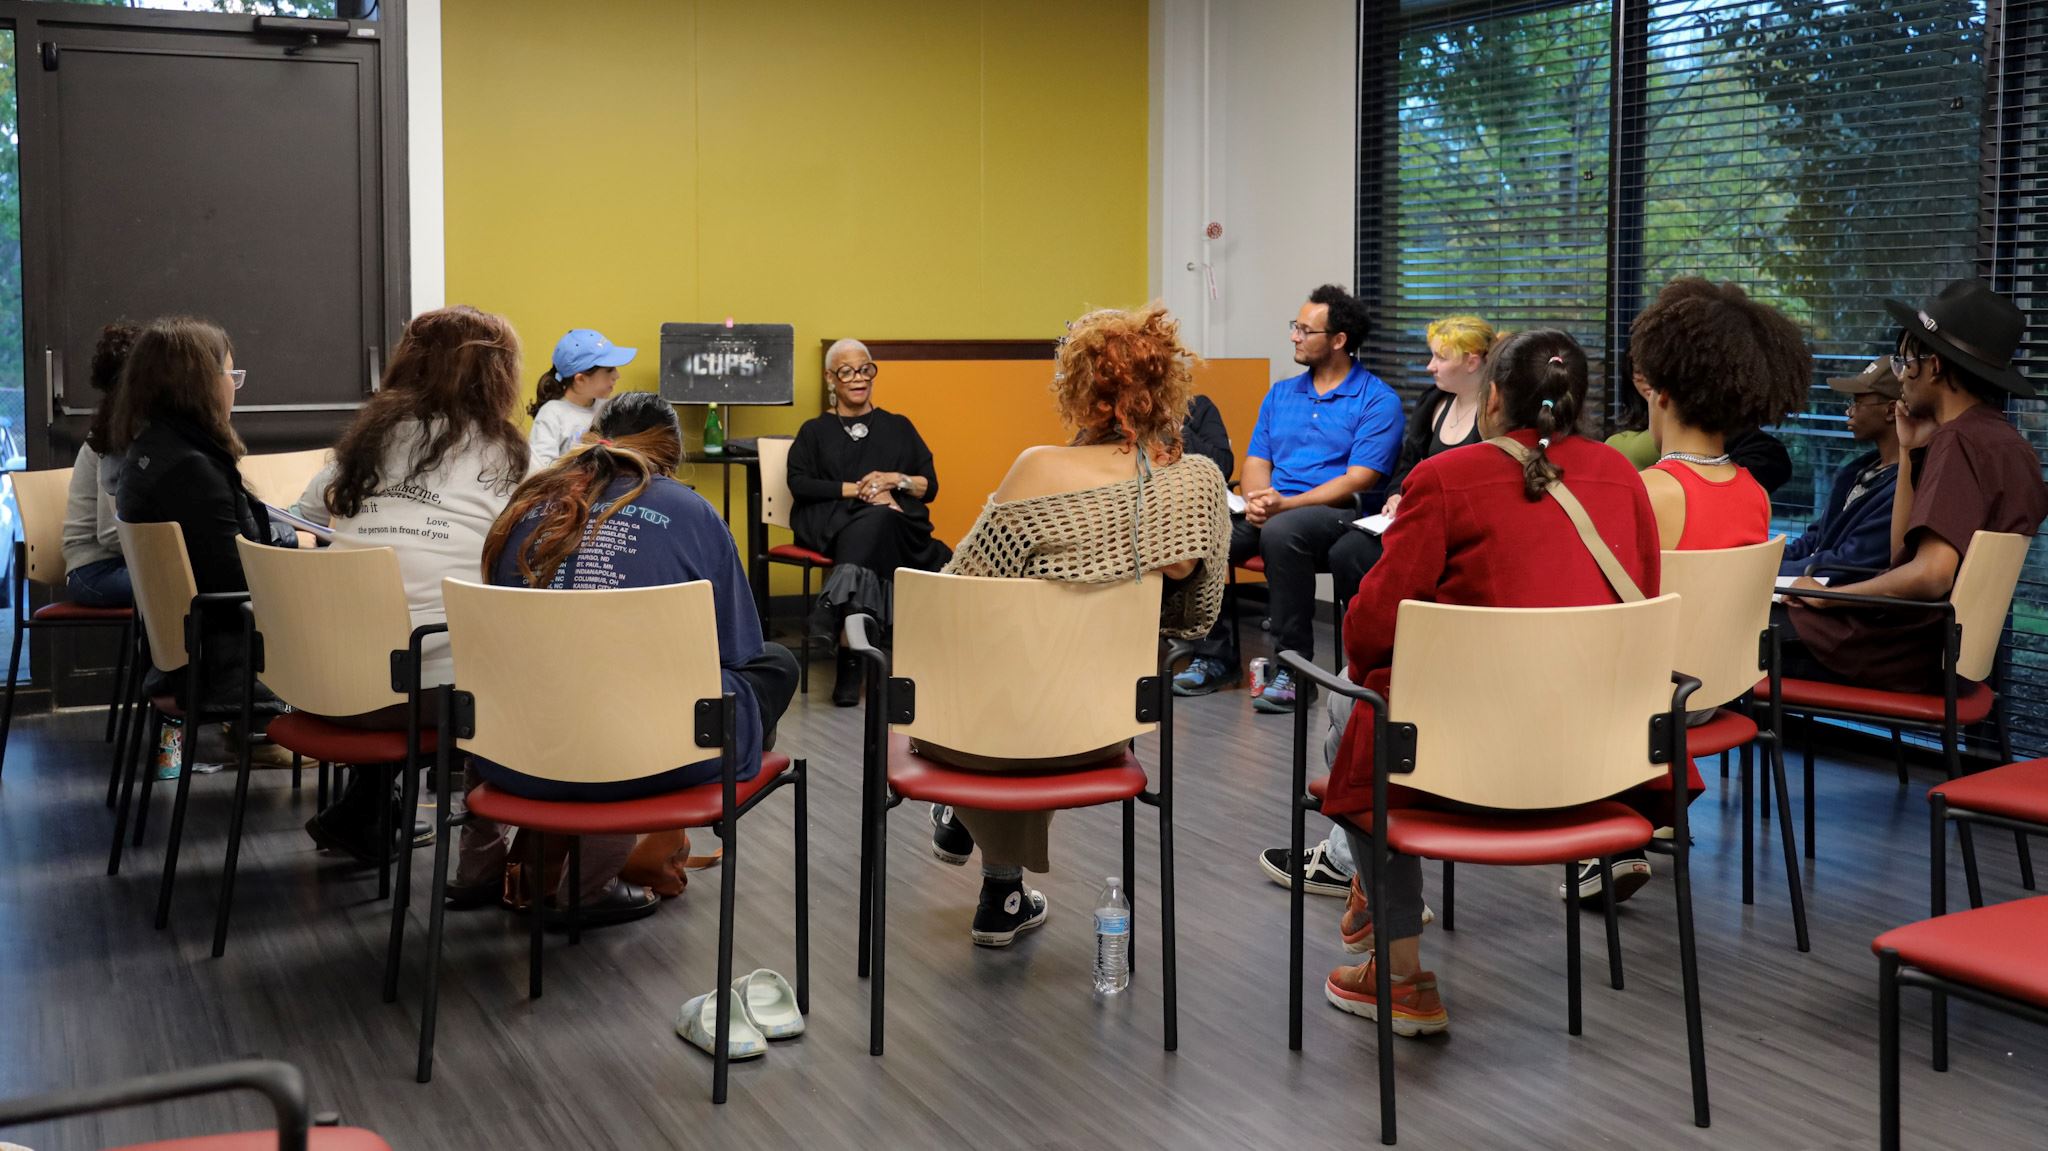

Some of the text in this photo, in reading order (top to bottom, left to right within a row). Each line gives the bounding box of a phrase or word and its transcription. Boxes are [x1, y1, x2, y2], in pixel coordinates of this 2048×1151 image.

[692, 353, 756, 377] CUPS
[370, 501, 378, 513] it
[426, 516, 450, 528] Love,
[590, 502, 636, 517] WOLD
[639, 506, 671, 529] TOUR
[358, 525, 449, 540] the person in front of you
[595, 542, 612, 550] LAKE
